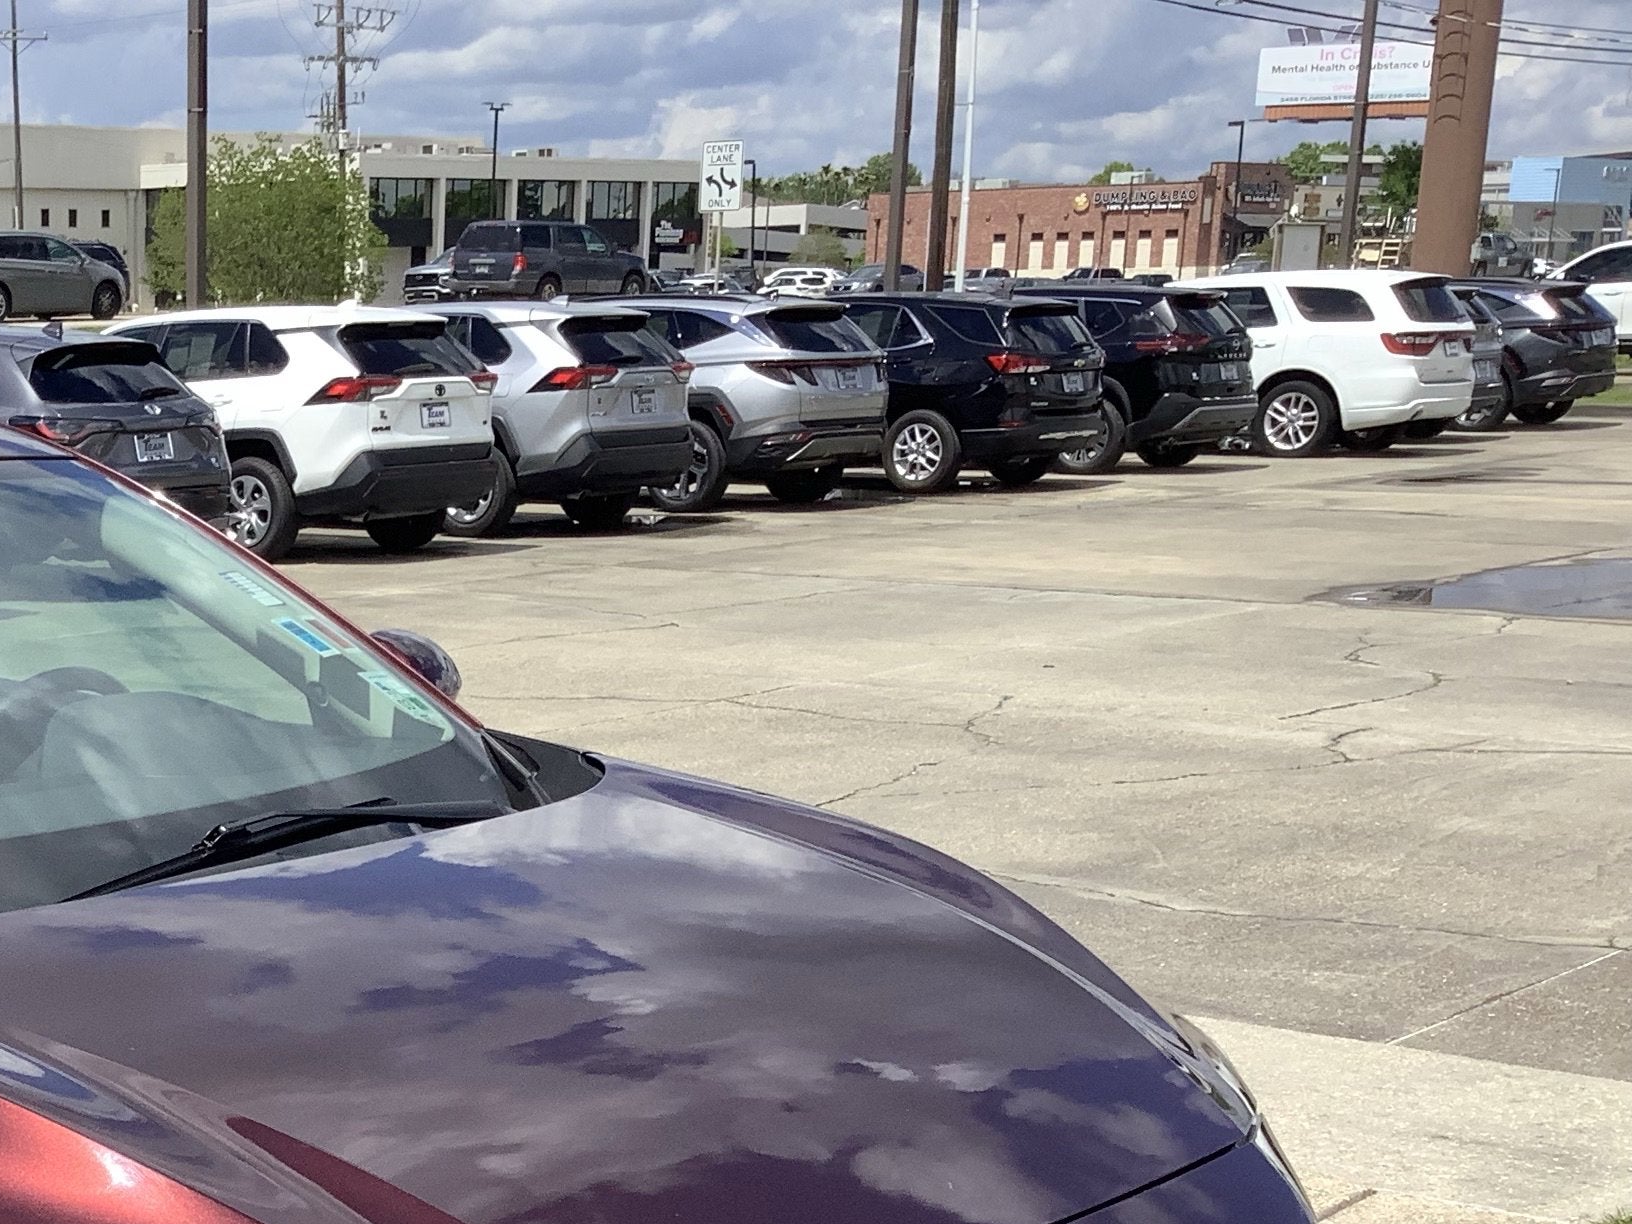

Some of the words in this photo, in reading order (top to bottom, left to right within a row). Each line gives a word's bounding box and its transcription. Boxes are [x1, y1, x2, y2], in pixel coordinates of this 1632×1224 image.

[1320, 49, 1335, 61] In
[1340, 46, 1395, 61] Cris?
[1271, 65, 1308, 74] Mental
[1311, 64, 1346, 73] Health
[705, 144, 741, 154] CENTER
[710, 154, 735, 163] LANE
[1093, 190, 1156, 204] DUMPING
[1171, 190, 1198, 202] BAO
[708, 199, 732, 208] ONLY
